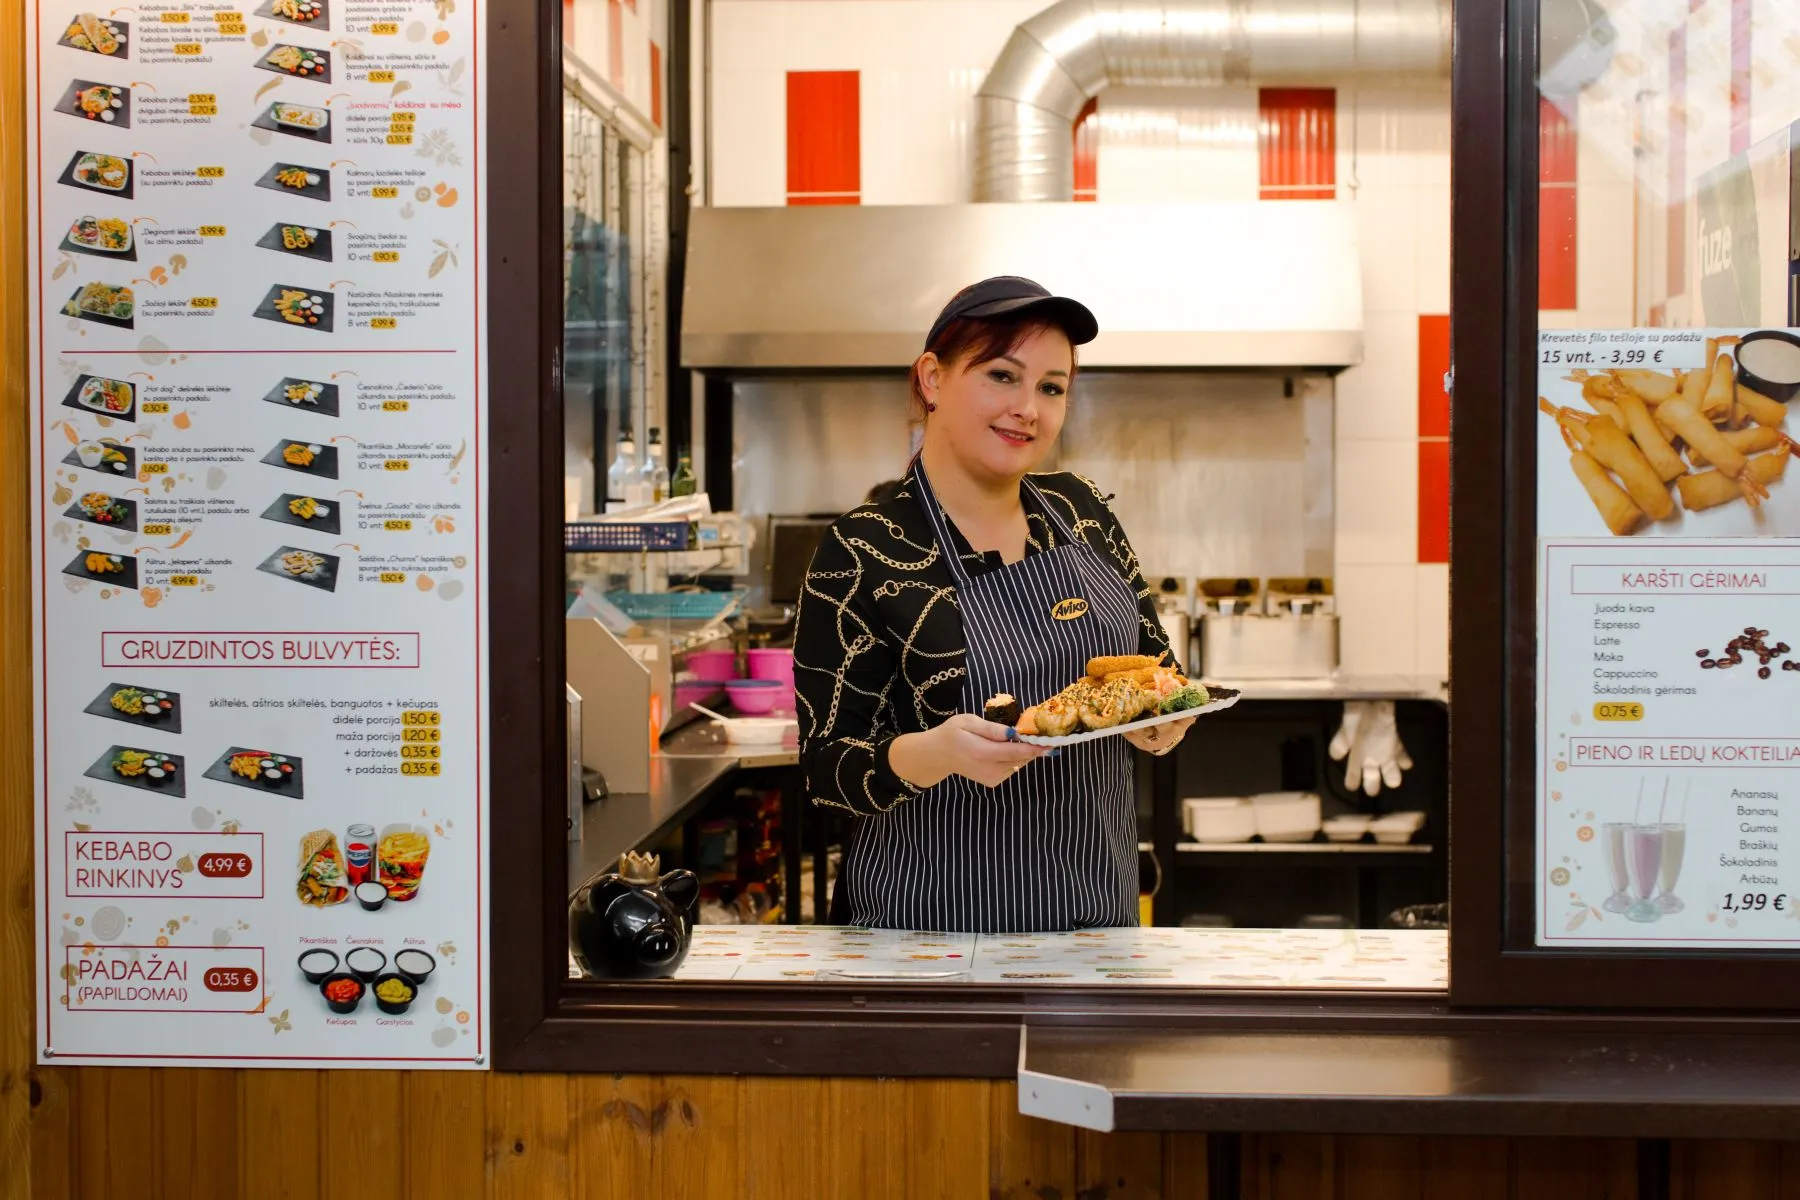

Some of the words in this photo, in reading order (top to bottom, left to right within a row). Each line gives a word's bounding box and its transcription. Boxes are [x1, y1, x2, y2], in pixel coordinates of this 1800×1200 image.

[1541, 332, 1587, 343] Krevetės
[1588, 332, 1607, 345] filo
[1610, 332, 1644, 345] tešloje
[1647, 334, 1660, 342] su
[1662, 332, 1702, 345] padažu
[1542, 350, 1561, 363] 15
[1566, 350, 1595, 363] vnt.
[1610, 350, 1645, 366] 3,99
[1652, 350, 1664, 363] €
[1621, 568, 1684, 588] KARŠTI
[1689, 569, 1767, 589] GĖRIMAI
[1594, 603, 1626, 616] Juoda
[1629, 603, 1655, 613] kava
[1593, 618, 1641, 631] Espresso
[1593, 635, 1621, 646] Latte
[121, 639, 275, 661] GRUZDINTOS
[282, 636, 401, 661] BULVYTĖS:
[1593, 651, 1624, 662] Moka
[1593, 667, 1659, 680] Cappuccino
[1593, 681, 1652, 695] Šokoladinis
[1655, 685, 1697, 697] gėrimas
[252, 698, 285, 709] aštrios
[330, 698, 383, 711] banguotos
[396, 698, 439, 710] kečupas
[1600, 705, 1628, 718] 0,75
[1630, 705, 1640, 718] €
[332, 714, 363, 725] didelė
[366, 715, 400, 727] porcija
[404, 713, 427, 726] 1,50
[430, 713, 439, 725] €
[336, 730, 363, 742] maža
[366, 731, 400, 744] porcija
[404, 729, 427, 743] 1,20
[430, 729, 439, 742] €
[401, 745, 427, 759] 0,35
[430, 746, 439, 759] €
[1577, 744, 1633, 761] PIENO
[1638, 744, 1655, 761] IR
[1660, 744, 1707, 764] LEDŲ
[355, 764, 398, 776] padažas
[401, 762, 427, 776] 0,35
[430, 763, 439, 775] €
[1730, 788, 1779, 801] Ananasų
[1736, 805, 1779, 818] Bananų
[1739, 822, 1778, 833] Gumos
[76, 841, 173, 861] KEBABO
[1739, 839, 1778, 851] Braškių
[203, 857, 233, 874] 4,99
[236, 857, 246, 873] €
[1719, 853, 1778, 867] Šokoladinis
[76, 868, 184, 889] RINKINYS
[1722, 892, 1768, 914] 1,99
[1772, 892, 1788, 912] €
[79, 953, 188, 982] PADAŽAI
[209, 972, 238, 987] 0,35
[242, 972, 253, 987] €
[78, 986, 188, 1003] (PAPILDOMAI)
